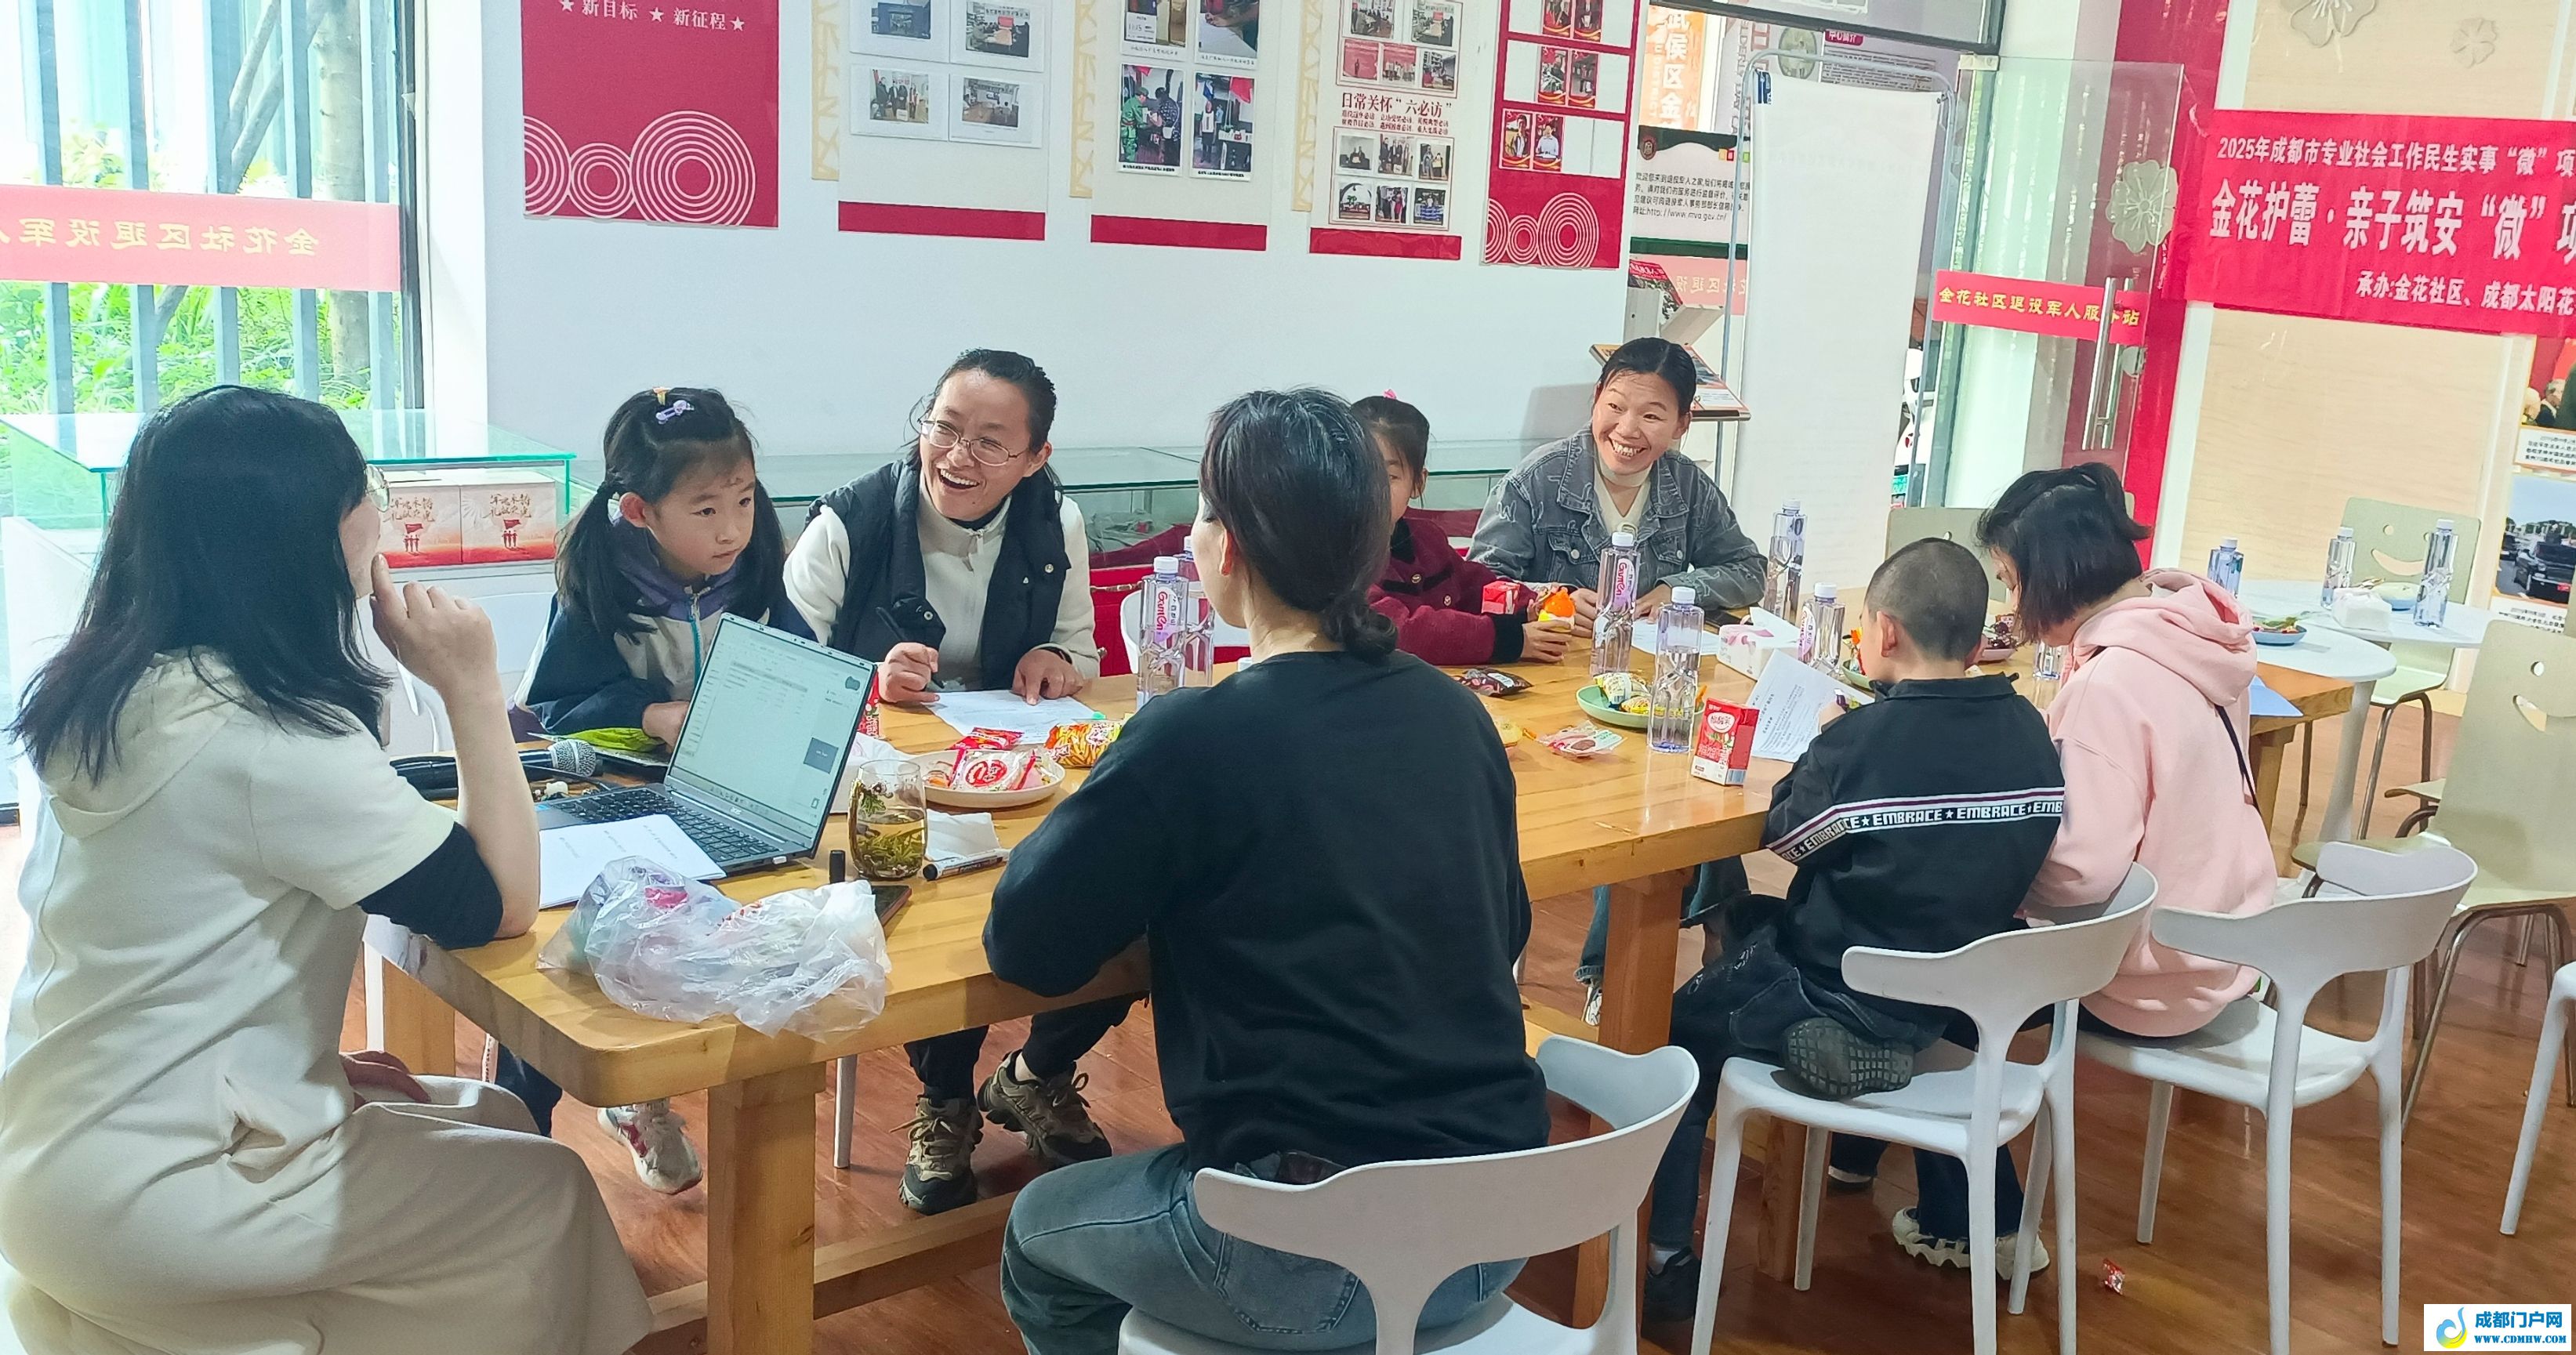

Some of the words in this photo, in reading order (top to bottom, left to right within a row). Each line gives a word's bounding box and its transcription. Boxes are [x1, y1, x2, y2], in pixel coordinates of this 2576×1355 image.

[582, 0, 637, 20] 新目标
[673, 7, 727, 31] 新征程
[1938, 287, 2140, 327] 金花社区退役军人服站
[1872, 809, 1943, 826] EMBRACE
[1957, 805, 2026, 820] EMBRACE
[2033, 801, 2063, 813] EMB
